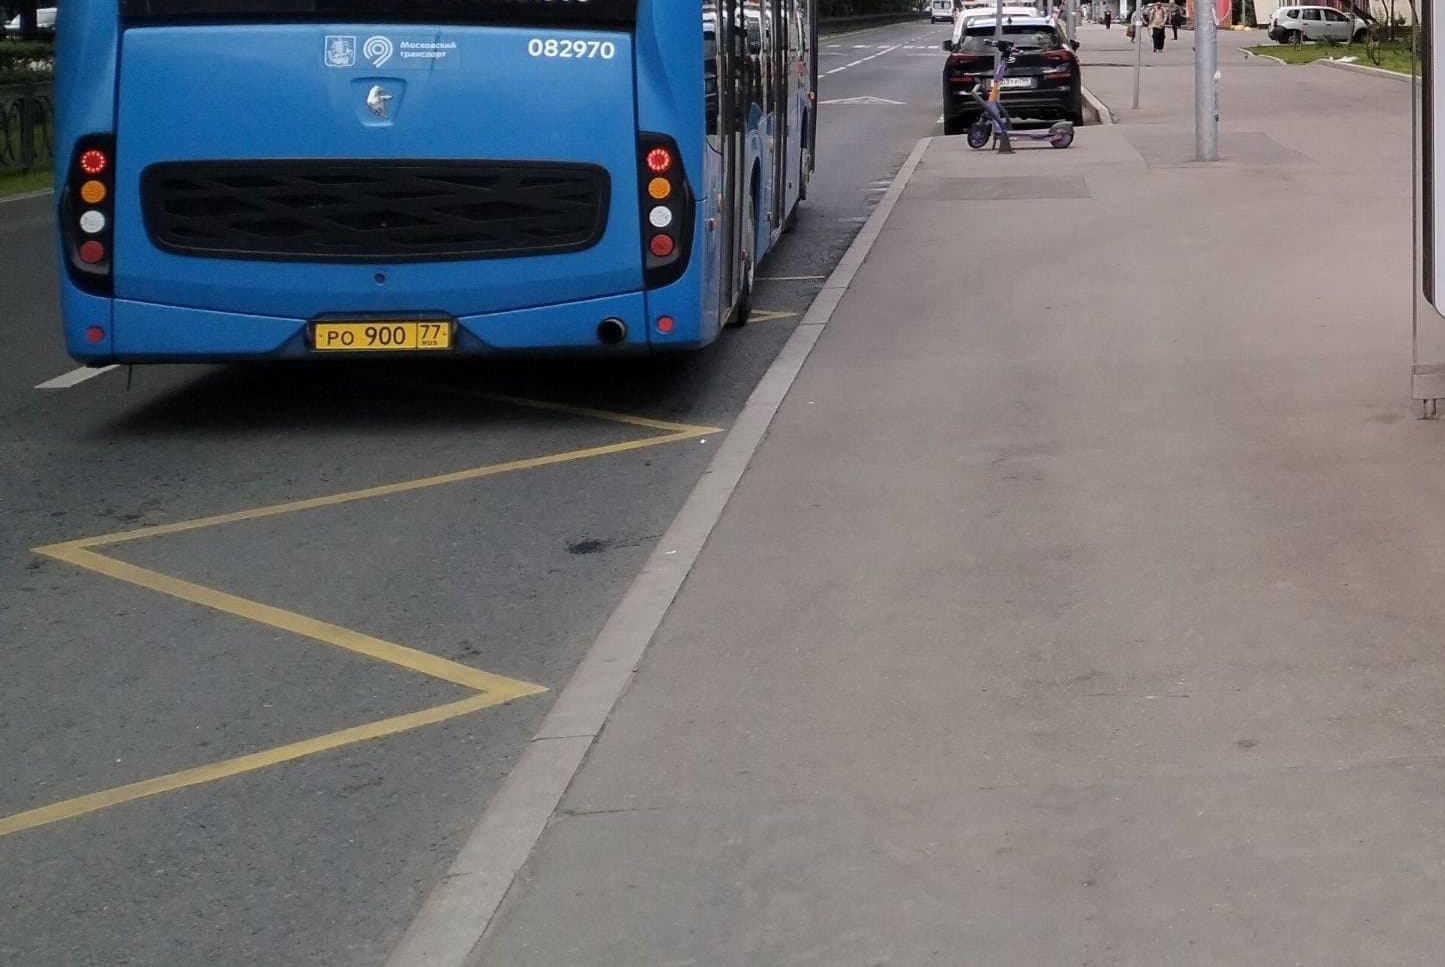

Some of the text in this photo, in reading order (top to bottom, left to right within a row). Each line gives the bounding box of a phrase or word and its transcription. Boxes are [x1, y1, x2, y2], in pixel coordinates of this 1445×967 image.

[527, 38, 616, 59] 082970
[327, 326, 406, 346] РО 900
[420, 324, 441, 340] 77
